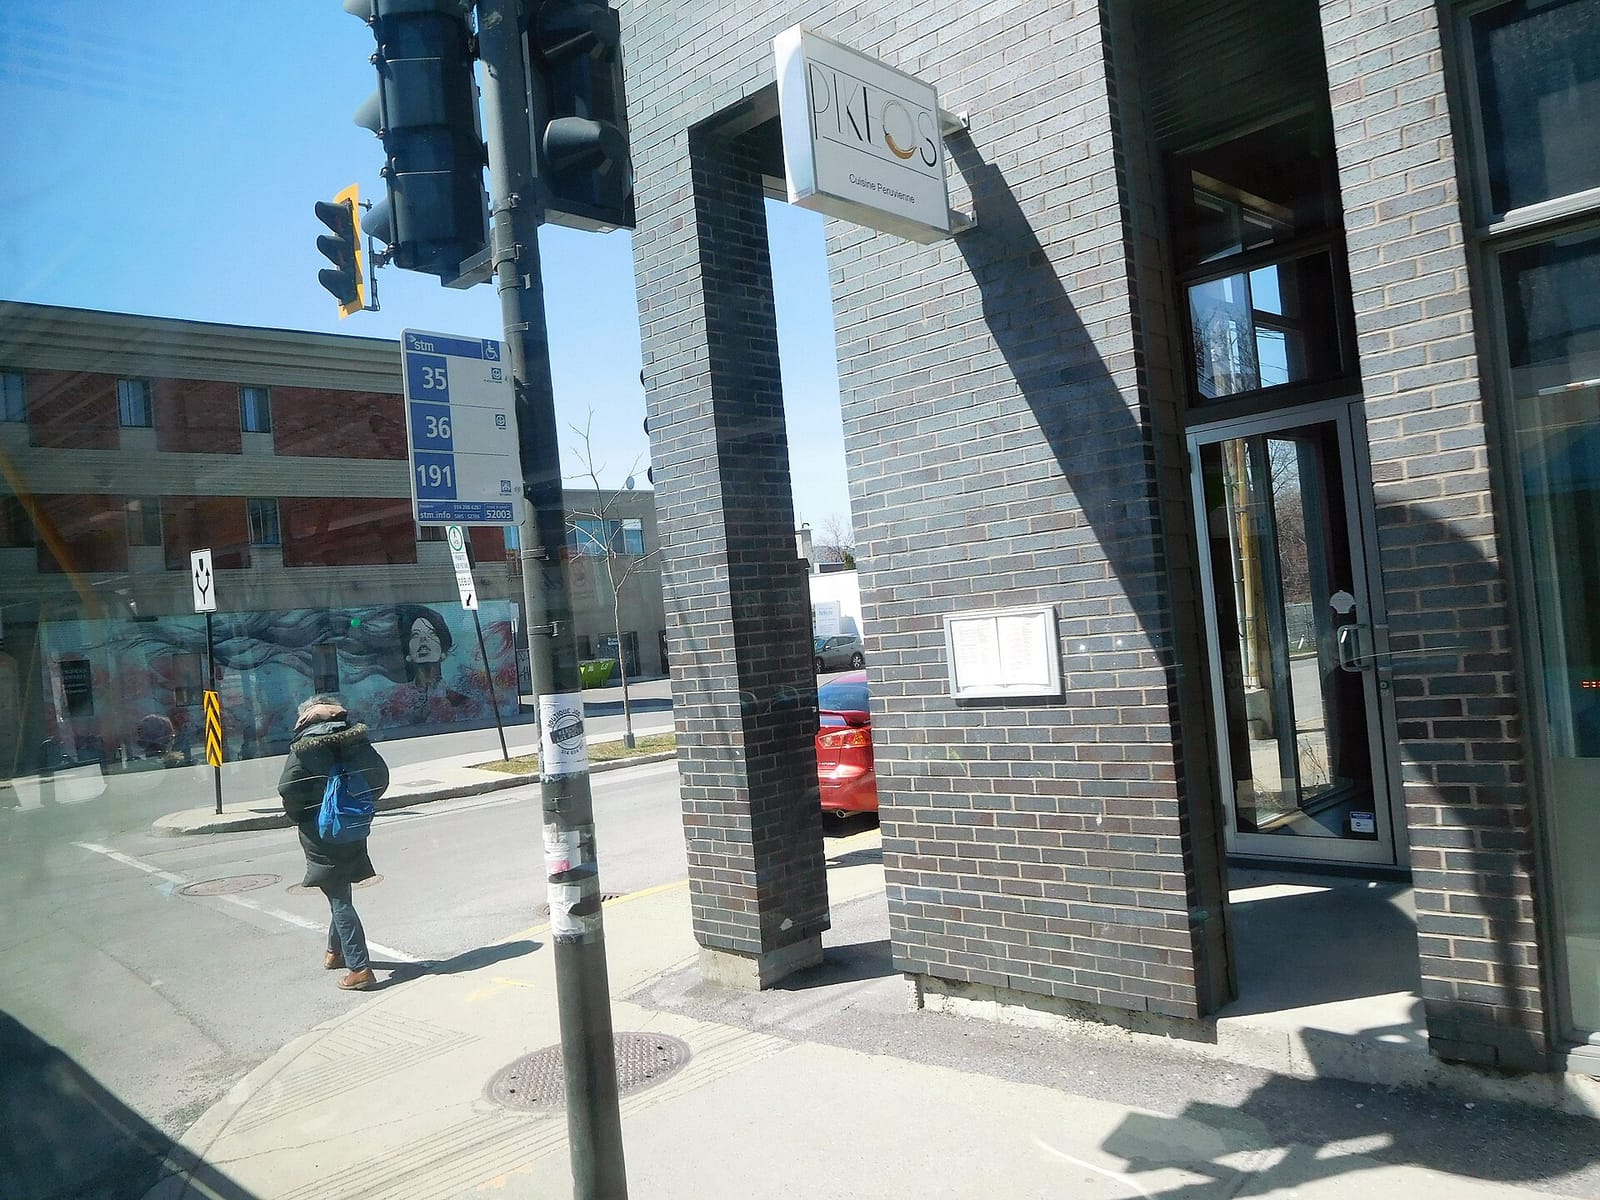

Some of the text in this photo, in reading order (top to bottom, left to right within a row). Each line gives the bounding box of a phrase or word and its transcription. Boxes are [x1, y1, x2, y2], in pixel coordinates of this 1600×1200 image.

[849, 173, 876, 191] Cuisine
[414, 340, 434, 352] stm
[422, 366, 447, 390] 35
[425, 415, 450, 439] 36
[416, 464, 452, 488] 191
[420, 509, 451, 519] stm.info
[486, 510, 511, 519] 52003
